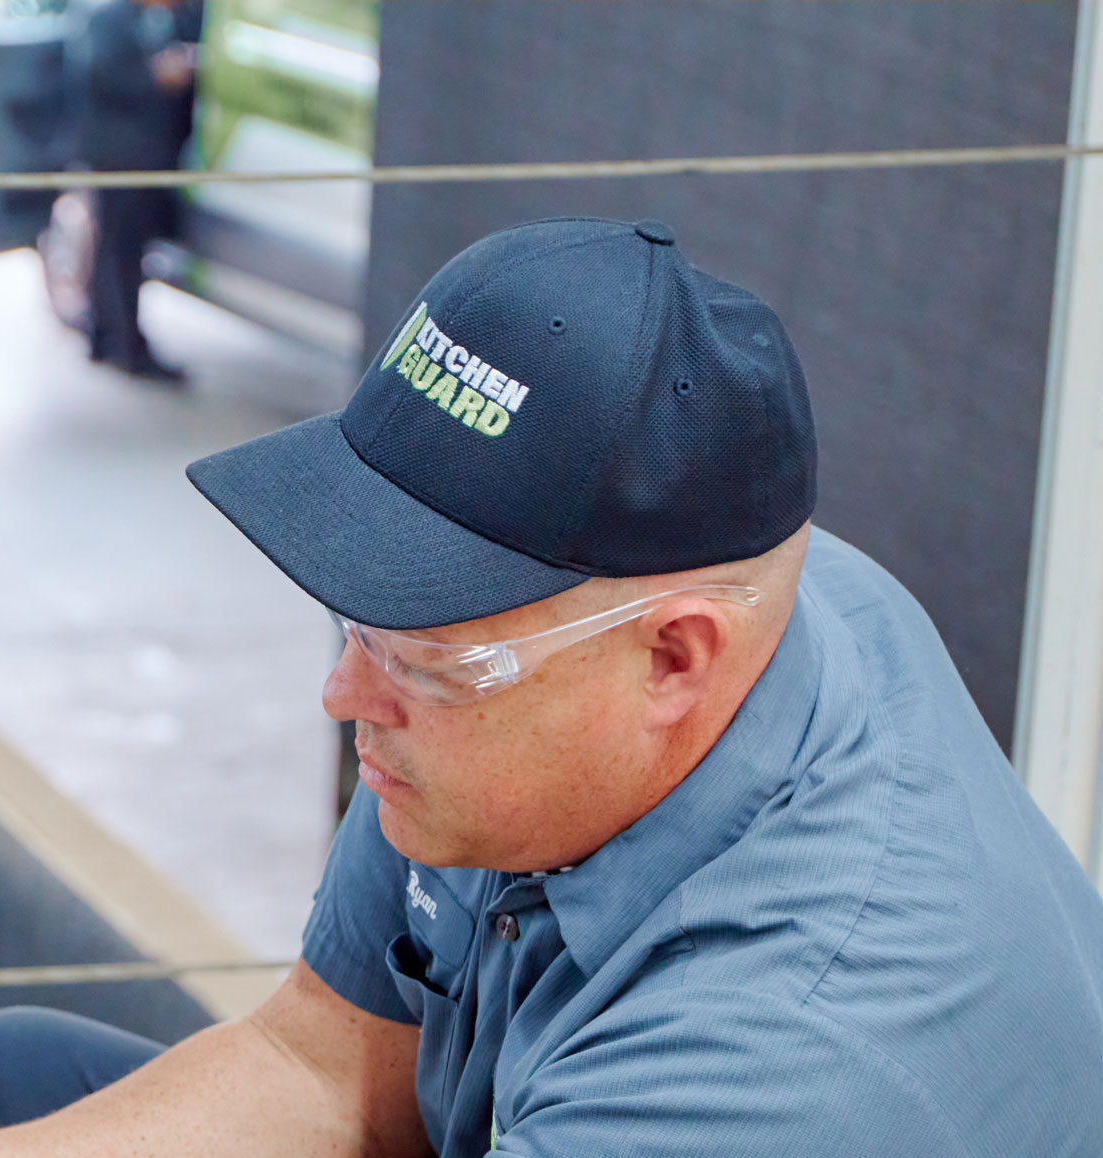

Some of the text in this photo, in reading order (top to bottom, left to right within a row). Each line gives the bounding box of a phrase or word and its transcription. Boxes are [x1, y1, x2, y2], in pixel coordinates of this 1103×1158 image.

[399, 343, 510, 437] GUARD
[416, 316, 530, 413] KITCHEN
[406, 870, 437, 919] Ryan
